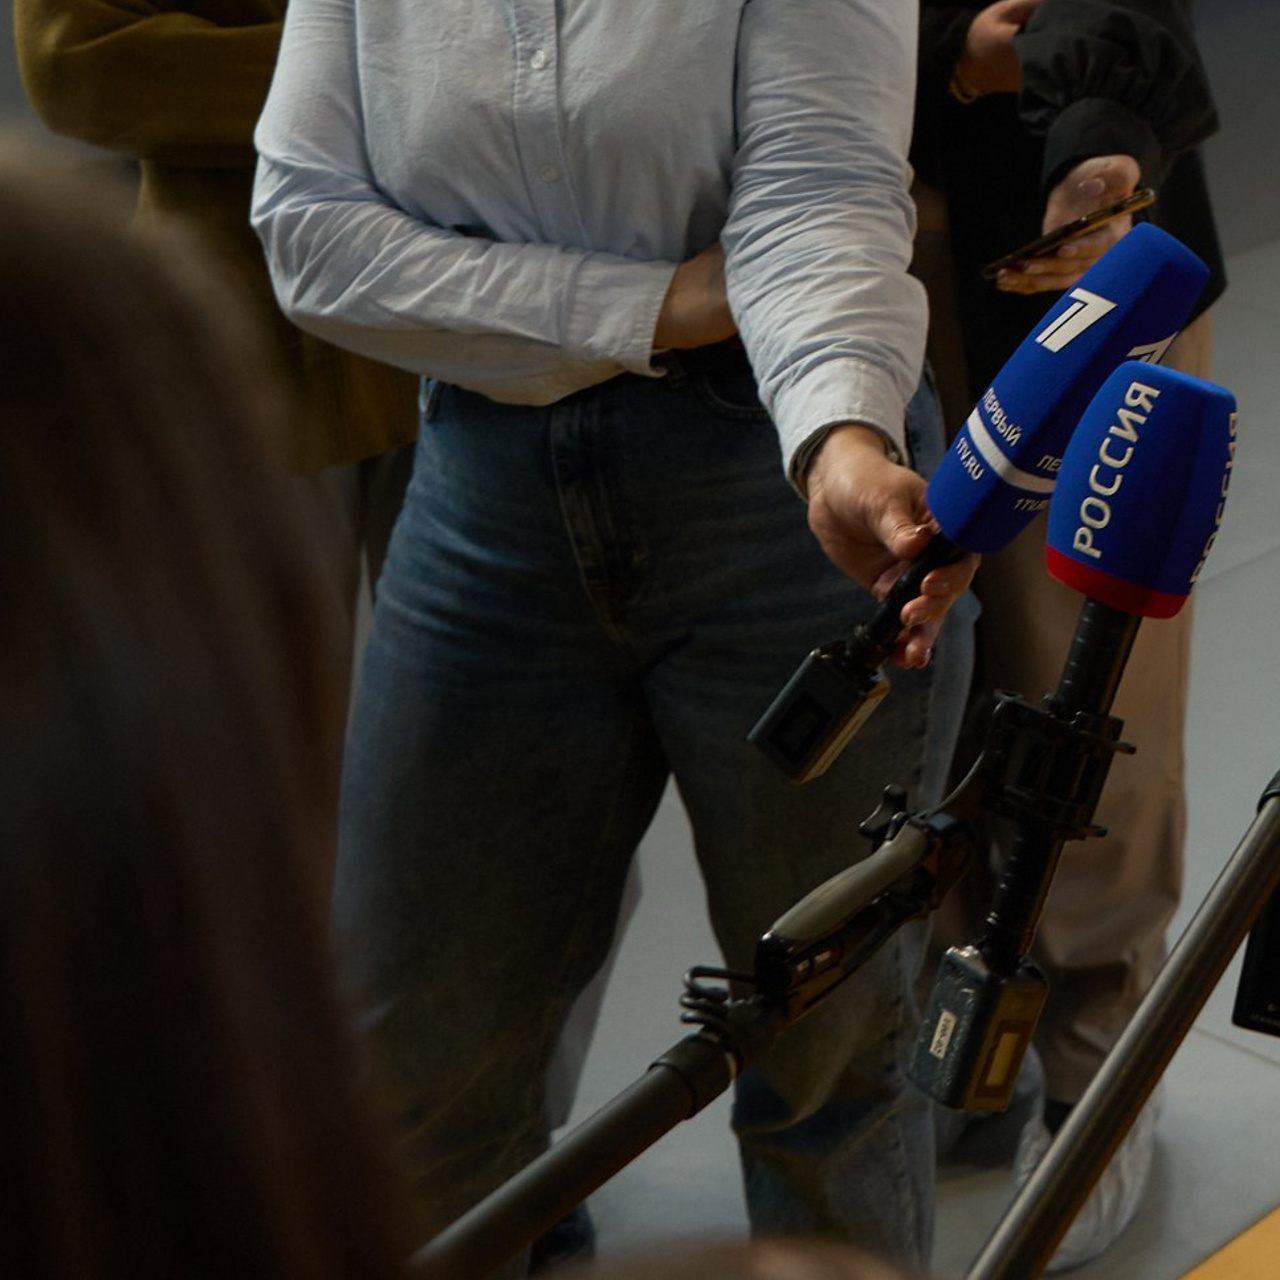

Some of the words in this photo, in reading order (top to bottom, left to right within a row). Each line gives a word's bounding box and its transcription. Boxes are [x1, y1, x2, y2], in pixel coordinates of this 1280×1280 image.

[983, 387, 1022, 447] ПЕРВЫЙ
[955, 437, 984, 481] 1TV.RU
[1073, 381, 1161, 559] РОССИЯ
